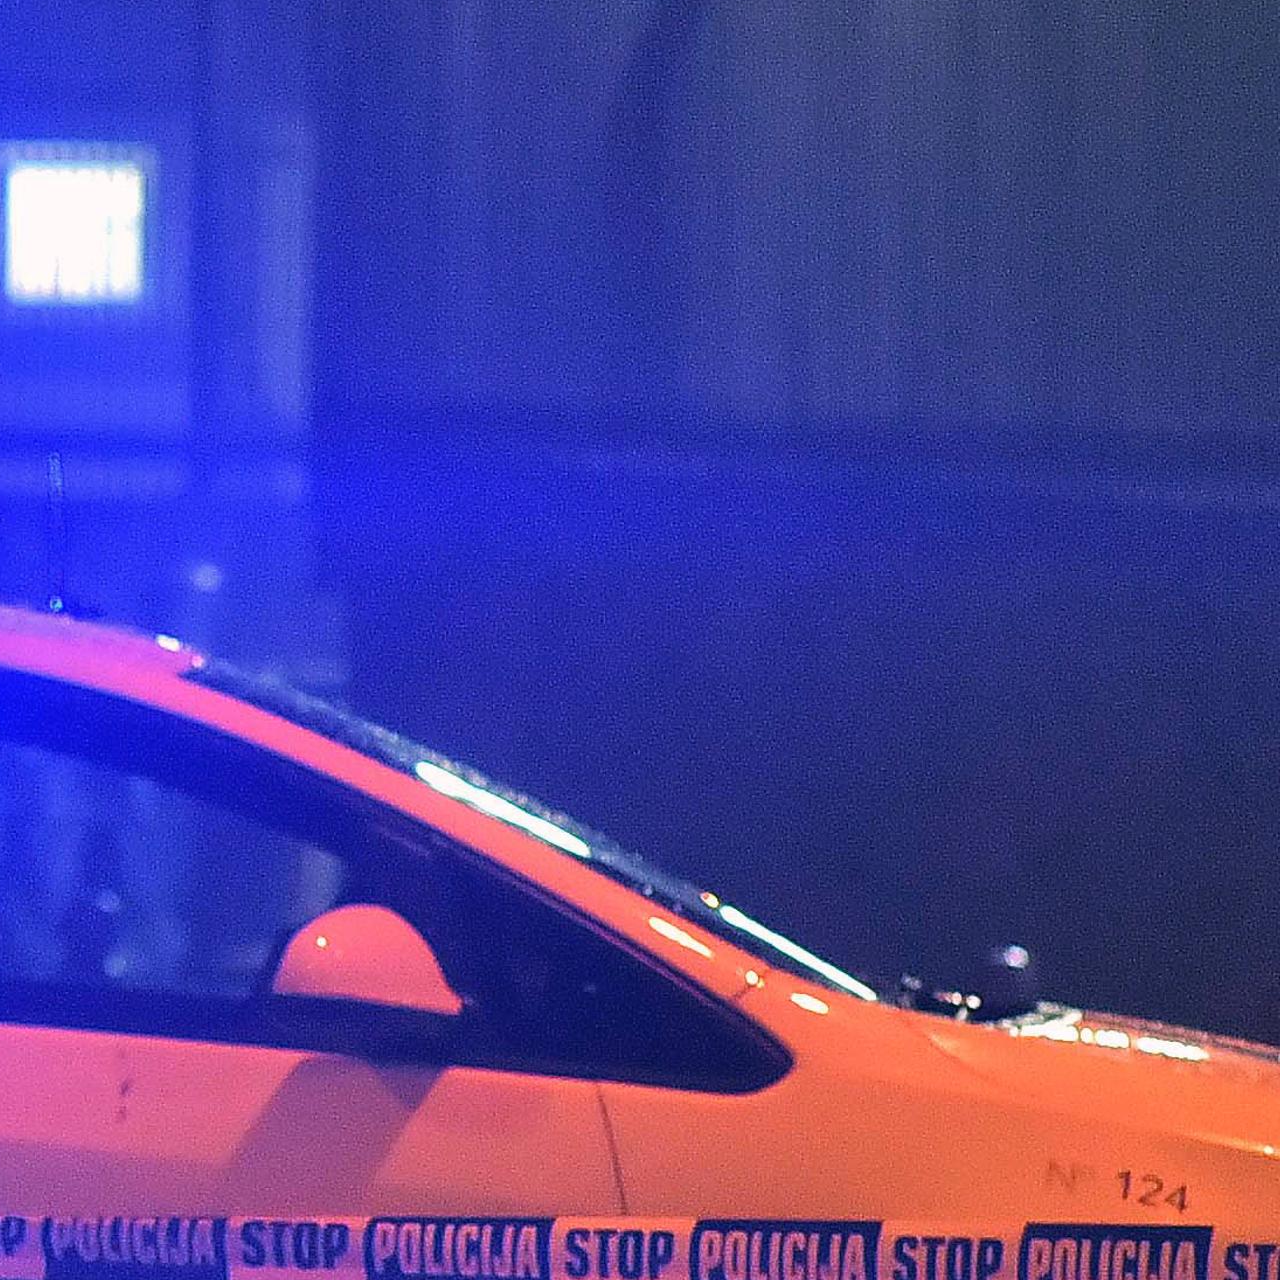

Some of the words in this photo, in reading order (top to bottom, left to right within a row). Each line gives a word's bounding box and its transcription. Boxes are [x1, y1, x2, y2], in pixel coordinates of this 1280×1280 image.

[1117, 1169, 1190, 1214] 124
[49, 1217, 216, 1266] POLICIJA
[240, 1220, 350, 1270] STOP
[372, 1222, 540, 1278] POLICIJA
[565, 1228, 675, 1280] STOP
